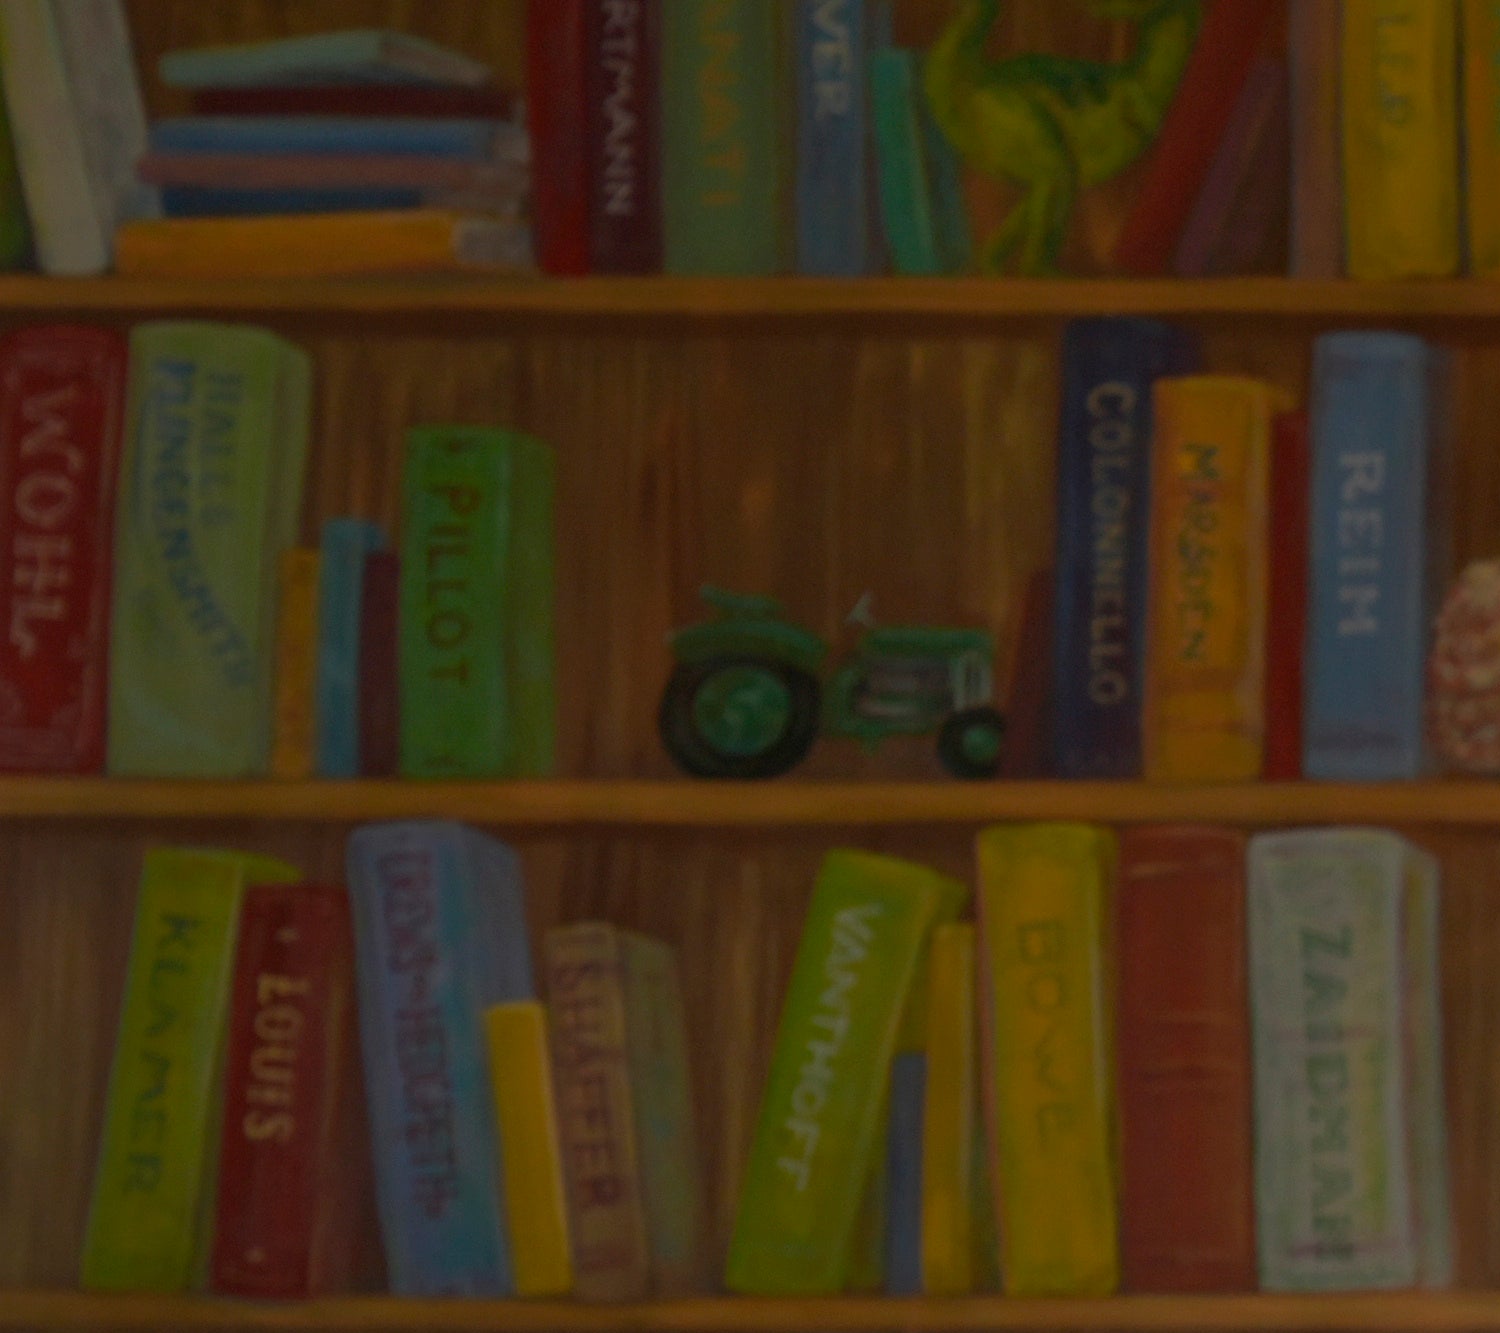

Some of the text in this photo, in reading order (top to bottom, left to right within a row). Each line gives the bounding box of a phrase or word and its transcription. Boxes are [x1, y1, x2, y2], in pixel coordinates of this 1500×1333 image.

[12, 385, 86, 659] WOHL
[426, 482, 483, 687] PILLOT
[1337, 450, 1386, 640] REIM
[244, 971, 311, 1145] LOUIS
